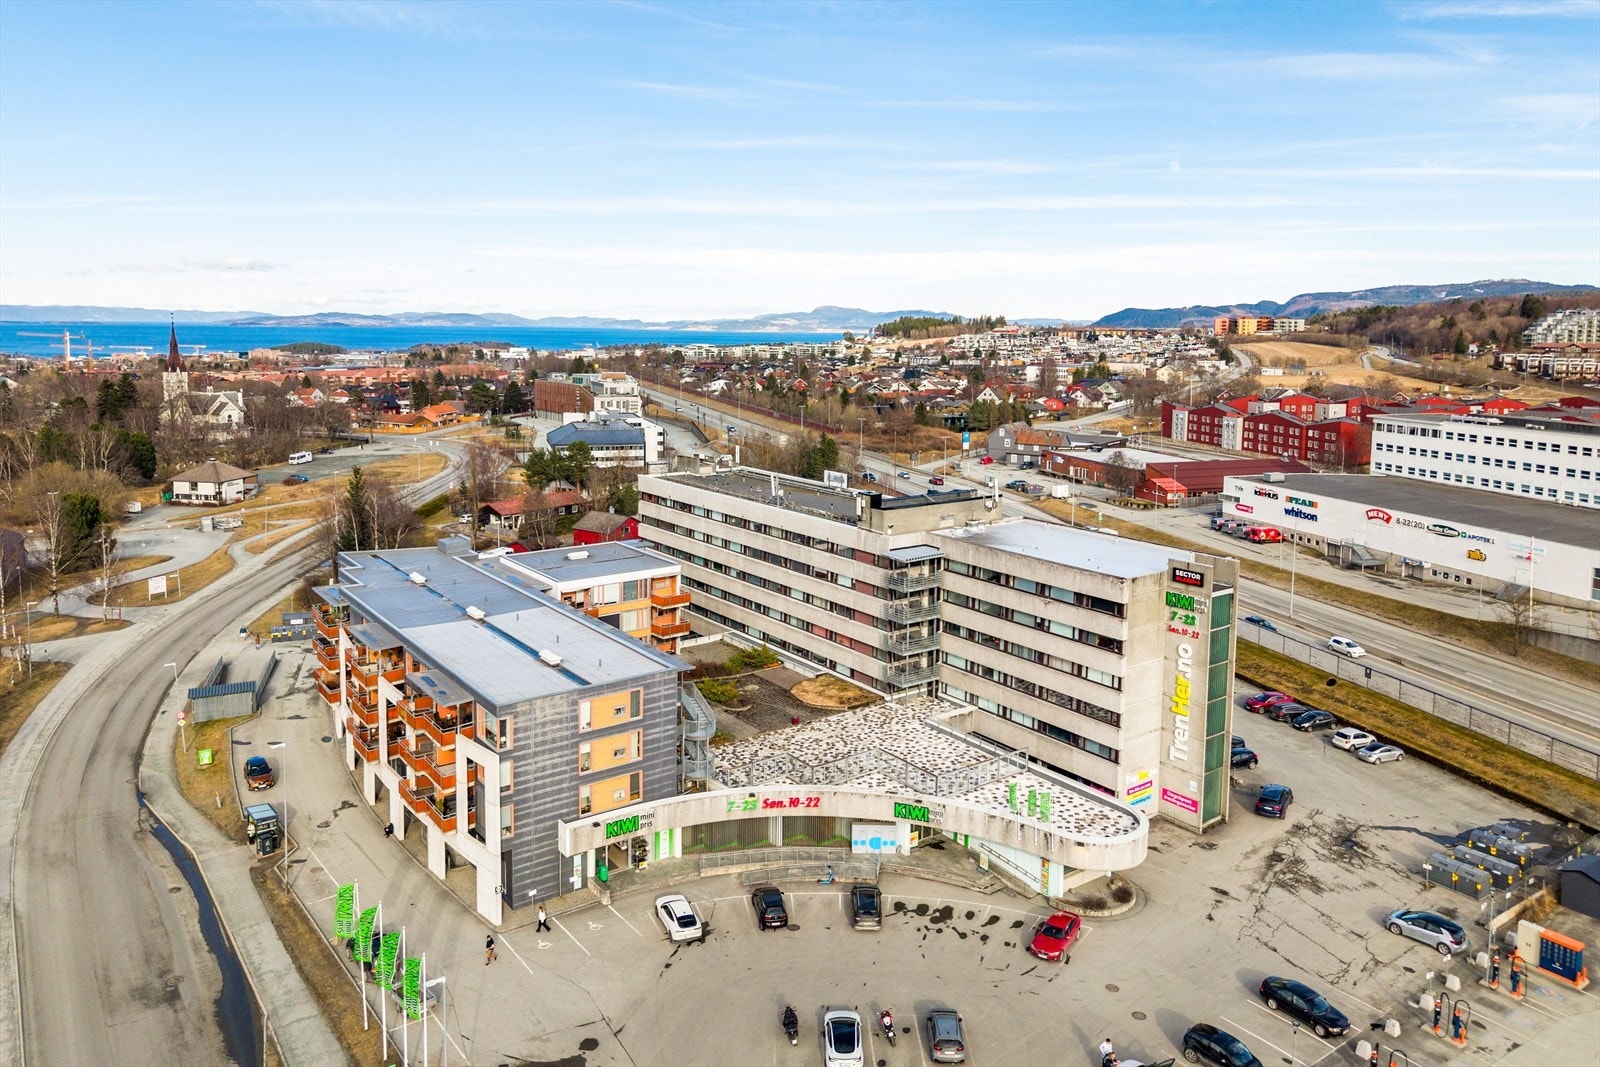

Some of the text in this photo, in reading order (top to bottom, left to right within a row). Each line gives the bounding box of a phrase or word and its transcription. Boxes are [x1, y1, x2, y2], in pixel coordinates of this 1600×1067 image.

[1284, 507, 1318, 522] whitson
[1467, 535, 1490, 544] APOTEK
[1175, 569, 1201, 581] SECTOR
[1166, 591, 1195, 611] KIWI
[1169, 643, 1193, 763] TrenHer.no
[726, 799, 757, 813] 7-23
[788, 796, 820, 809] 10-22
[894, 802, 929, 823] KIWI
[640, 811, 655, 822] mini
[640, 819, 653, 831] pris
[605, 814, 640, 840] KIWI
[337, 884, 354, 919] KIWI
